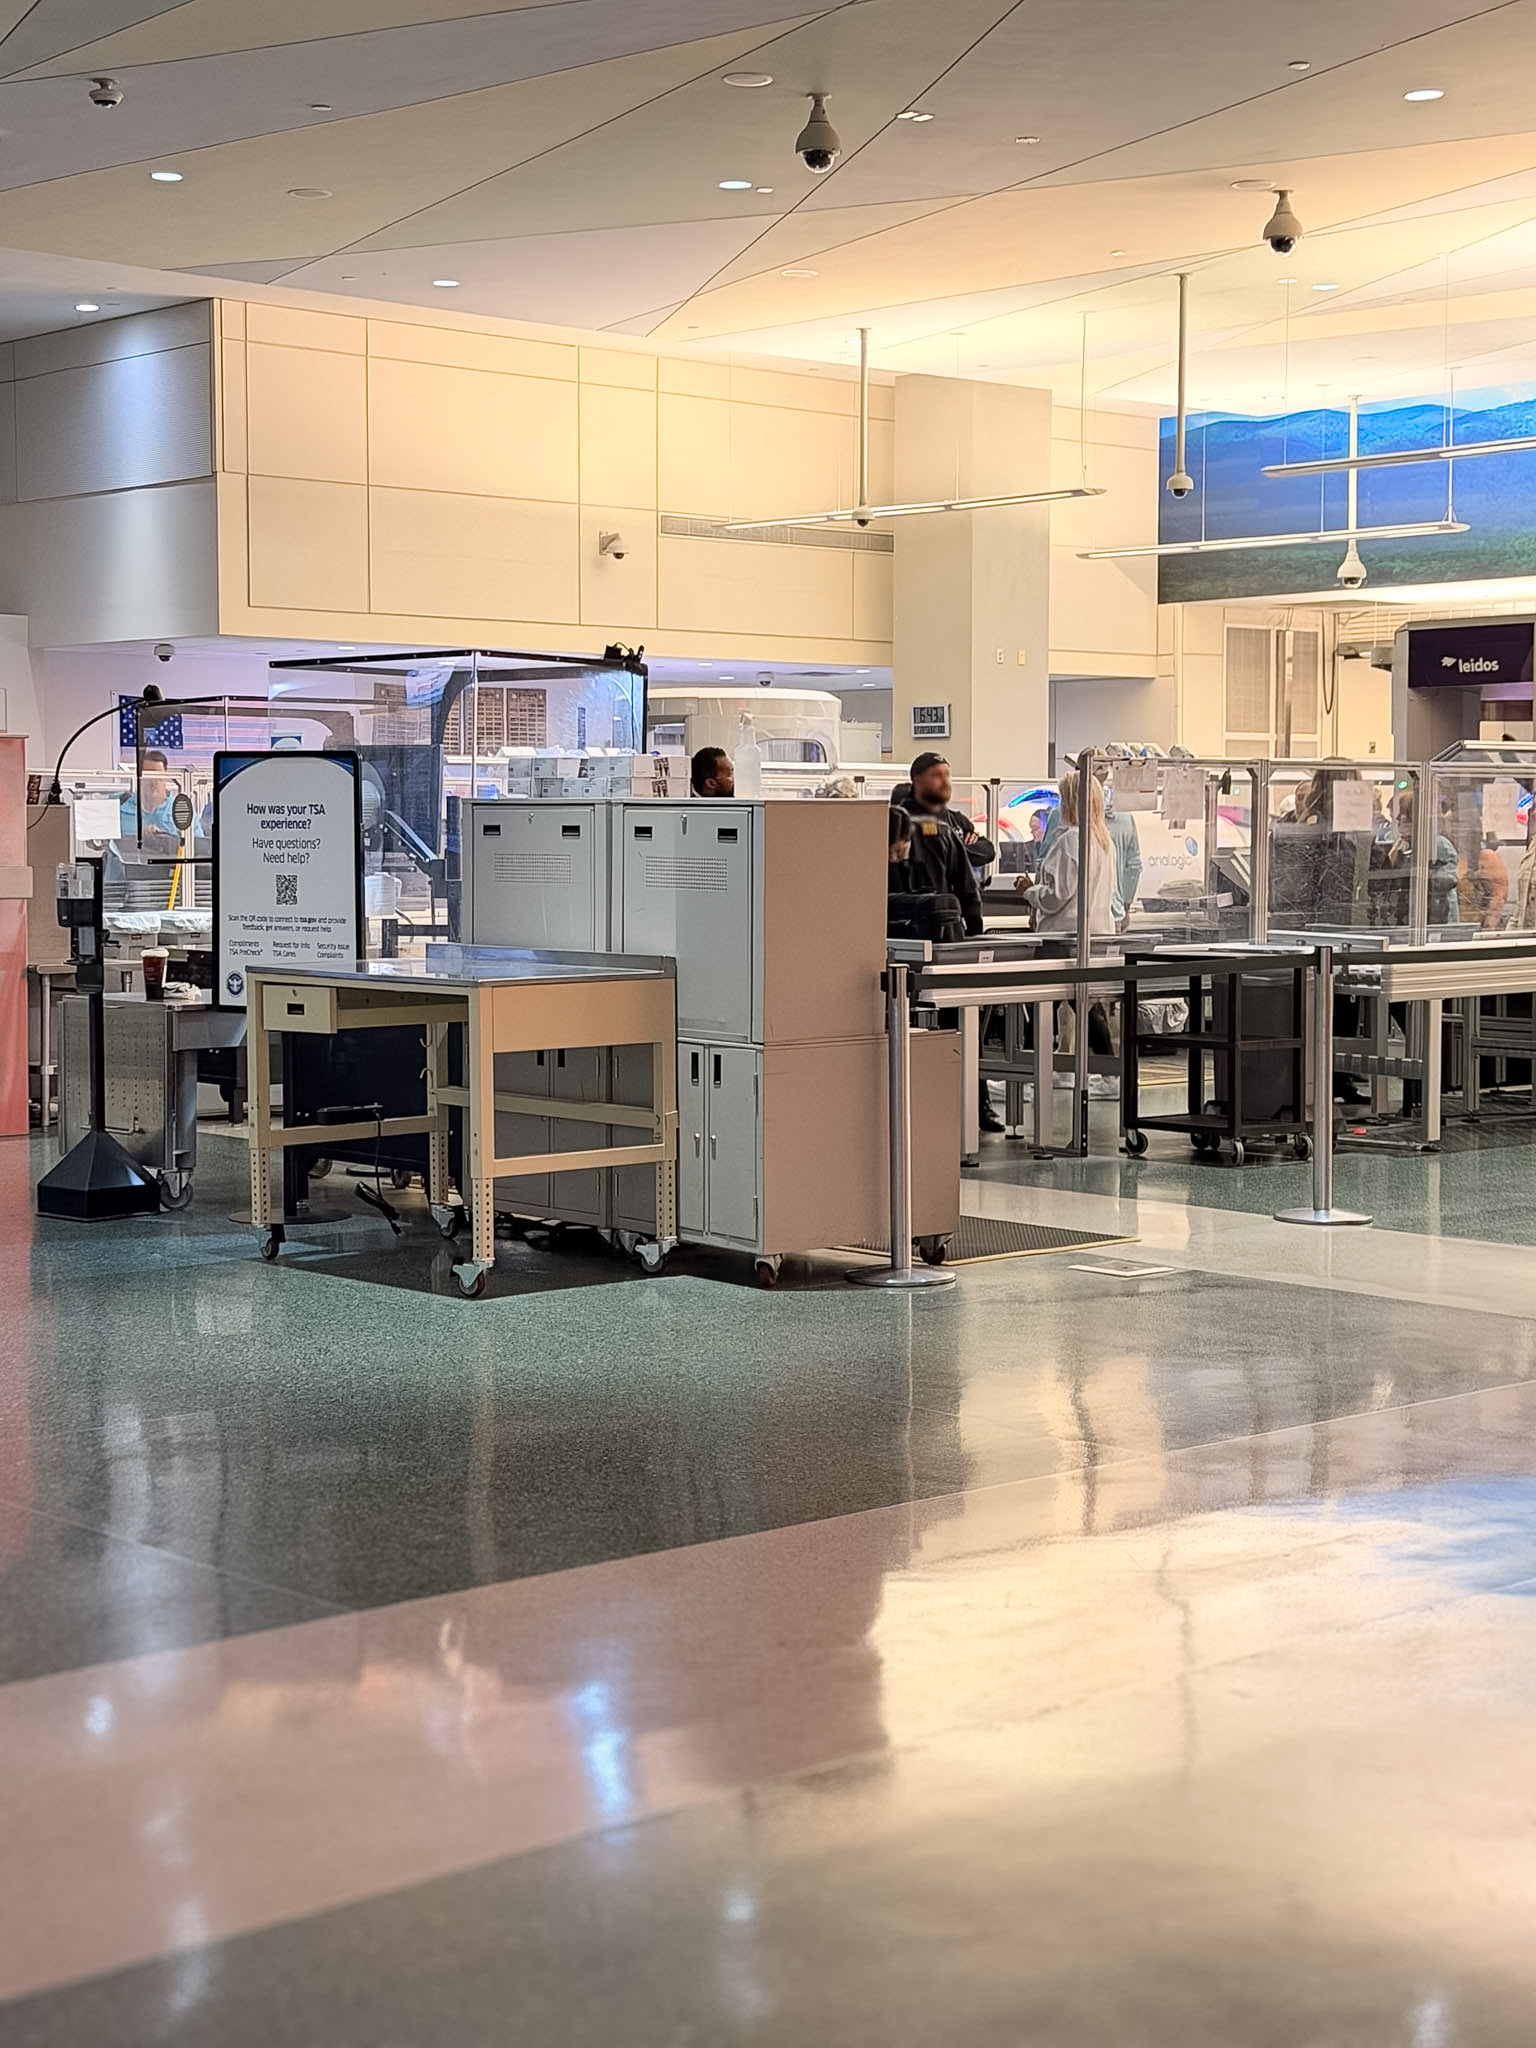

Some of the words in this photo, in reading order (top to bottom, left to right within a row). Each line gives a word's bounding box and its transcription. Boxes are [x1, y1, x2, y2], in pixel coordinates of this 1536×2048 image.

[1458, 657, 1499, 673] leidos
[247, 803, 266, 814] How
[268, 805, 285, 814] was
[287, 805, 307, 816] your
[308, 803, 326, 815] TSA
[261, 817, 312, 831] experience?
[252, 838, 274, 849] Have
[276, 837, 321, 850] questions?
[263, 852, 285, 863] Need
[287, 852, 310, 864] help?
[229, 940, 260, 948] Compliments
[317, 942, 336, 950] Security
[283, 950, 296, 958] Cares
[317, 951, 344, 959] Complaints
